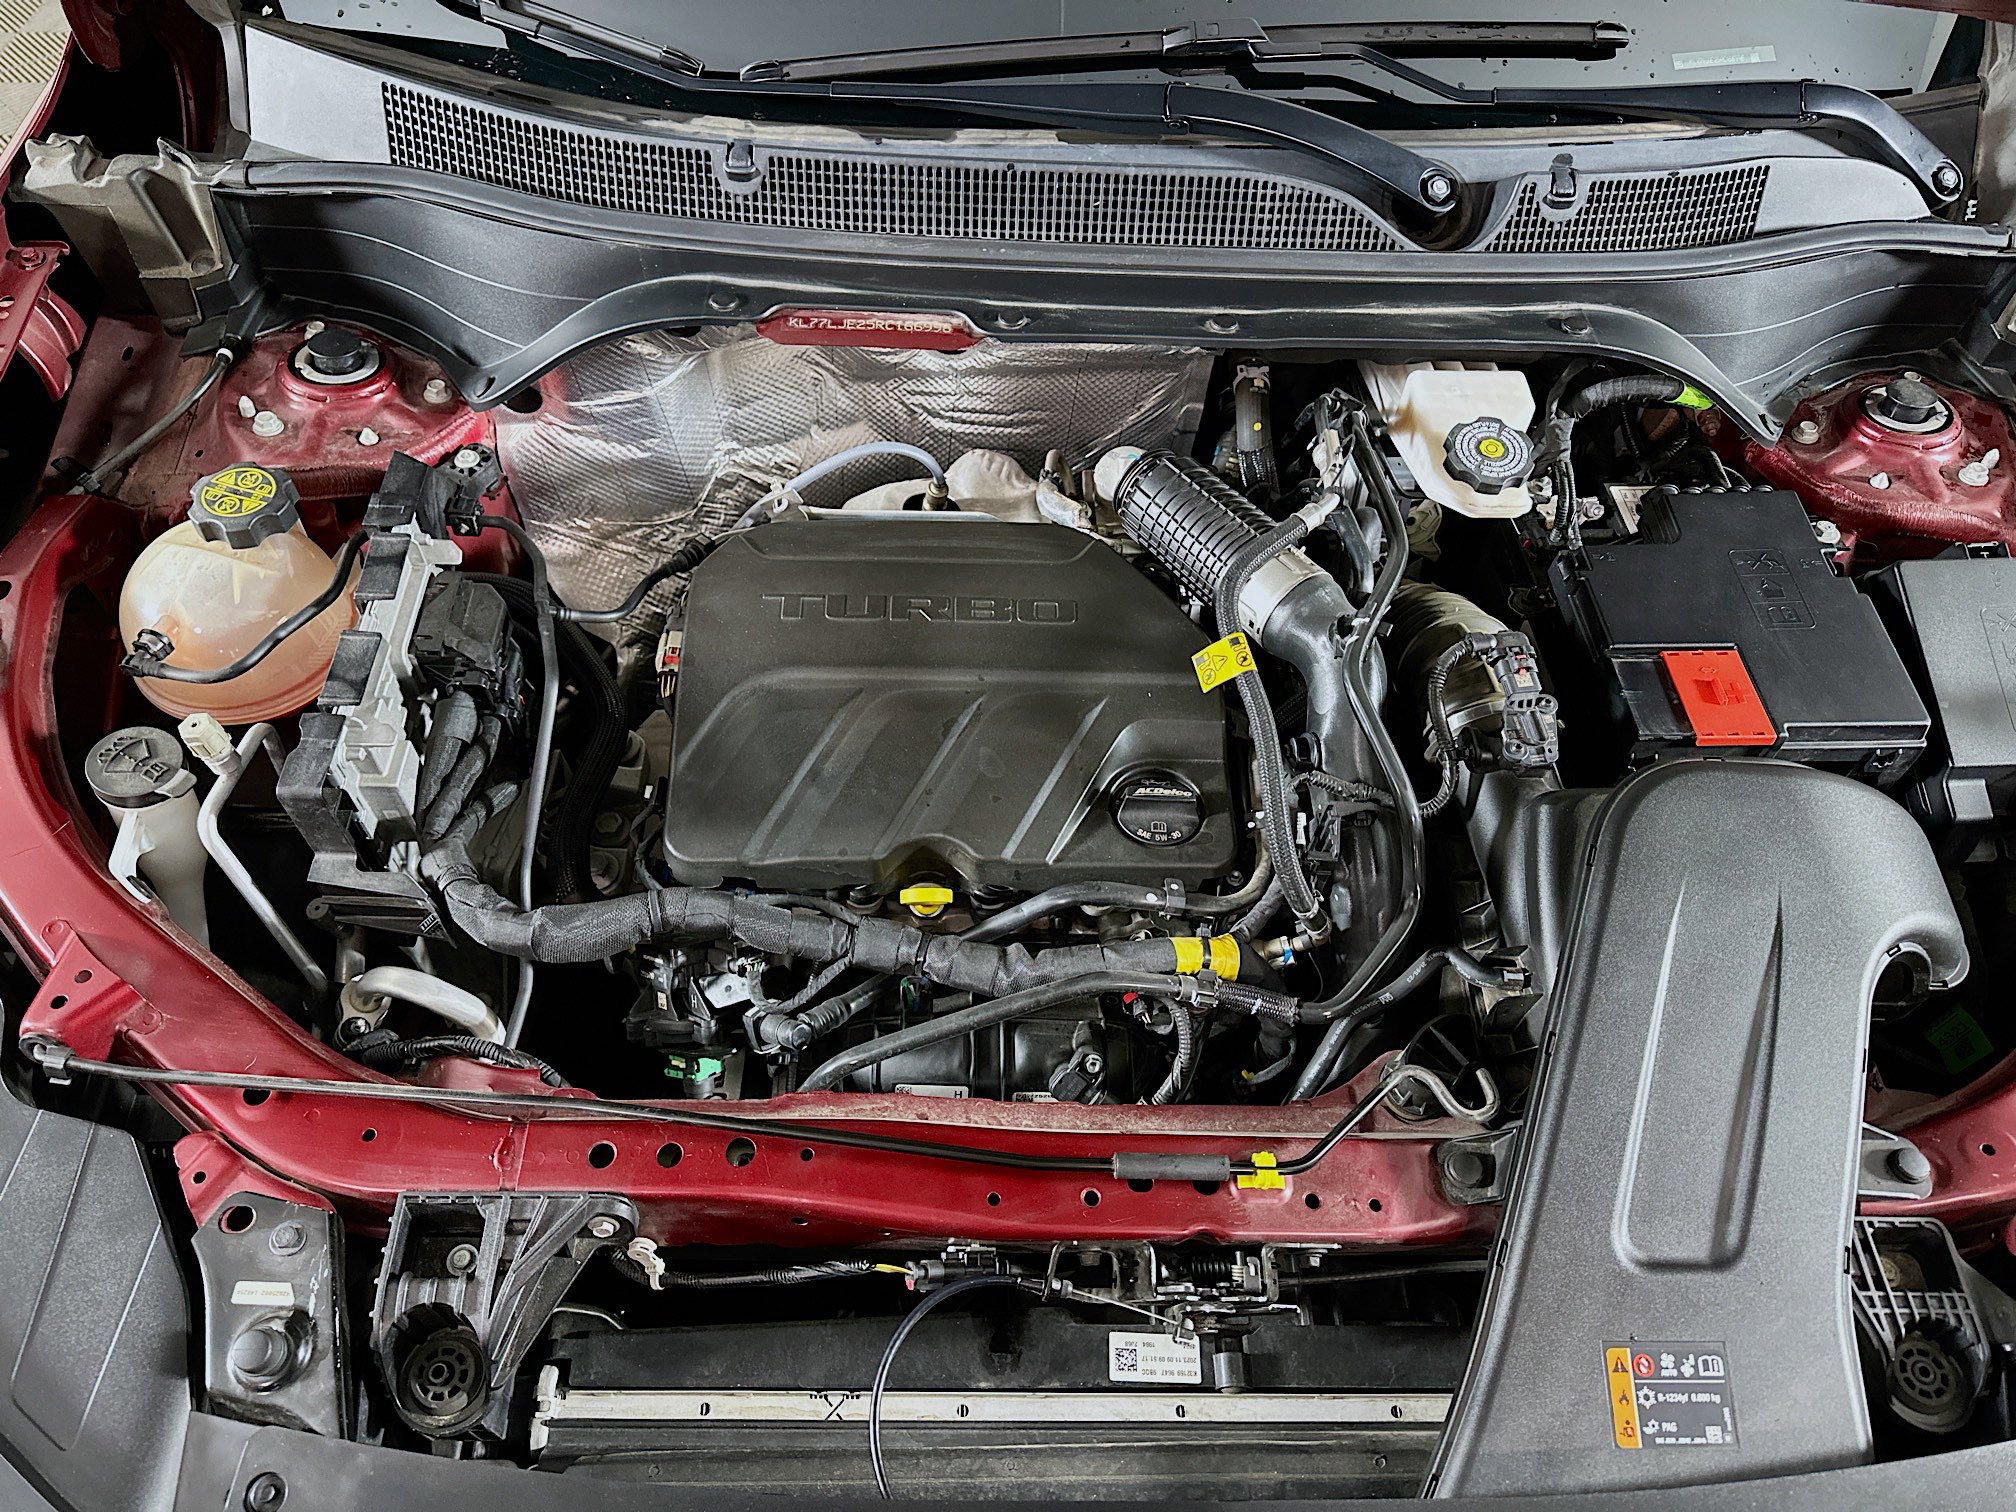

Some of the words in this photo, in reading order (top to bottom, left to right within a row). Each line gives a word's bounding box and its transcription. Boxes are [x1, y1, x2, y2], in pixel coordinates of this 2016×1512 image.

[761, 592, 1077, 625] TURBO
[1133, 787, 1193, 797] ACDelco
[1136, 828, 1152, 840] SAE
[1154, 830, 1182, 842] 5W-30
[1379, 991, 1394, 1005] GM
[954, 1090, 963, 1099] H
[1661, 1422, 1678, 1432] PAG
